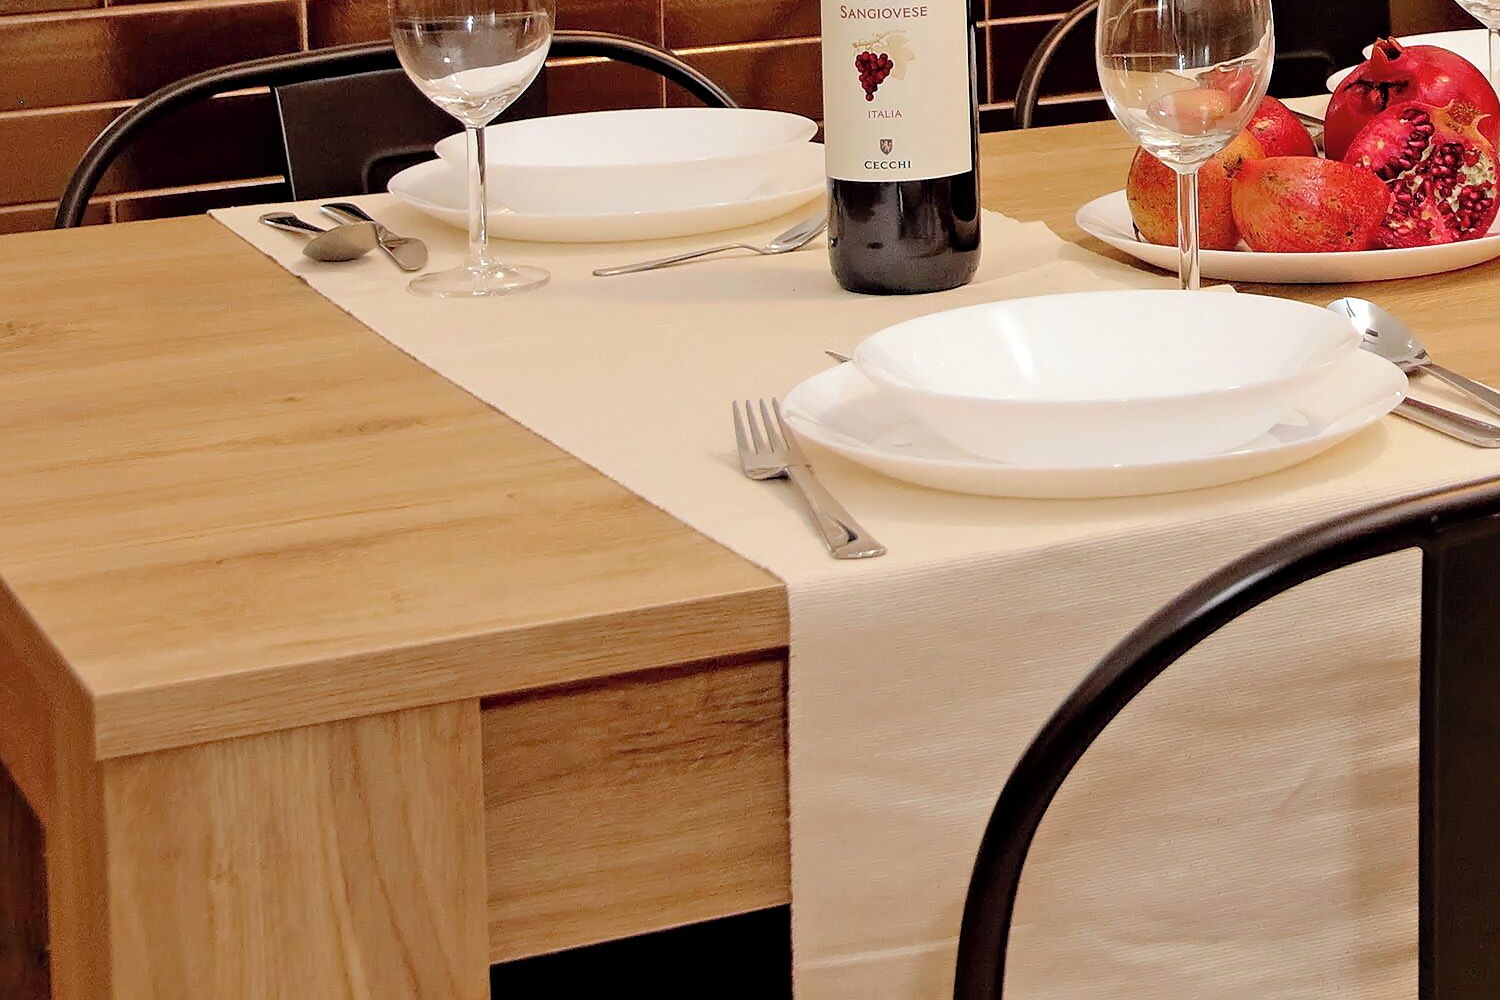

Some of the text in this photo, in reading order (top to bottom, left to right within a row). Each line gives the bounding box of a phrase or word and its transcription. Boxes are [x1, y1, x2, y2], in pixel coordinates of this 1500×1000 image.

[840, 5, 928, 19] SANGIOVESE
[868, 110, 903, 118] ITALIA
[864, 160, 911, 170] CECCHI
